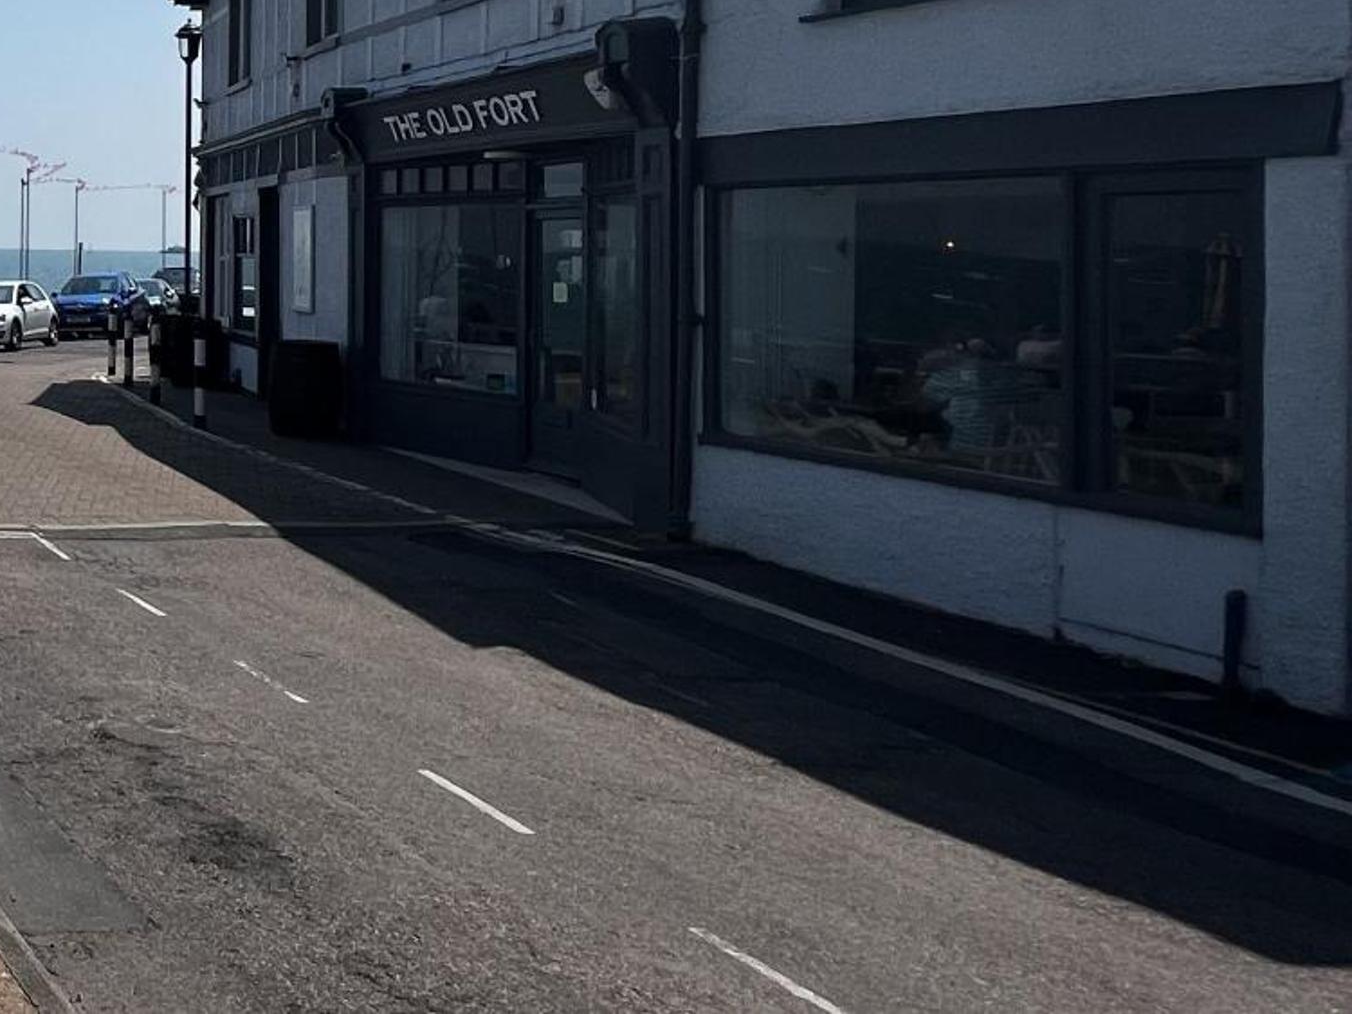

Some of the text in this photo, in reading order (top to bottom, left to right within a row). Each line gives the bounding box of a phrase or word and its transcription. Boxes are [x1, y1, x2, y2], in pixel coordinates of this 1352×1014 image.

[383, 90, 540, 142] THE OLD FORT
